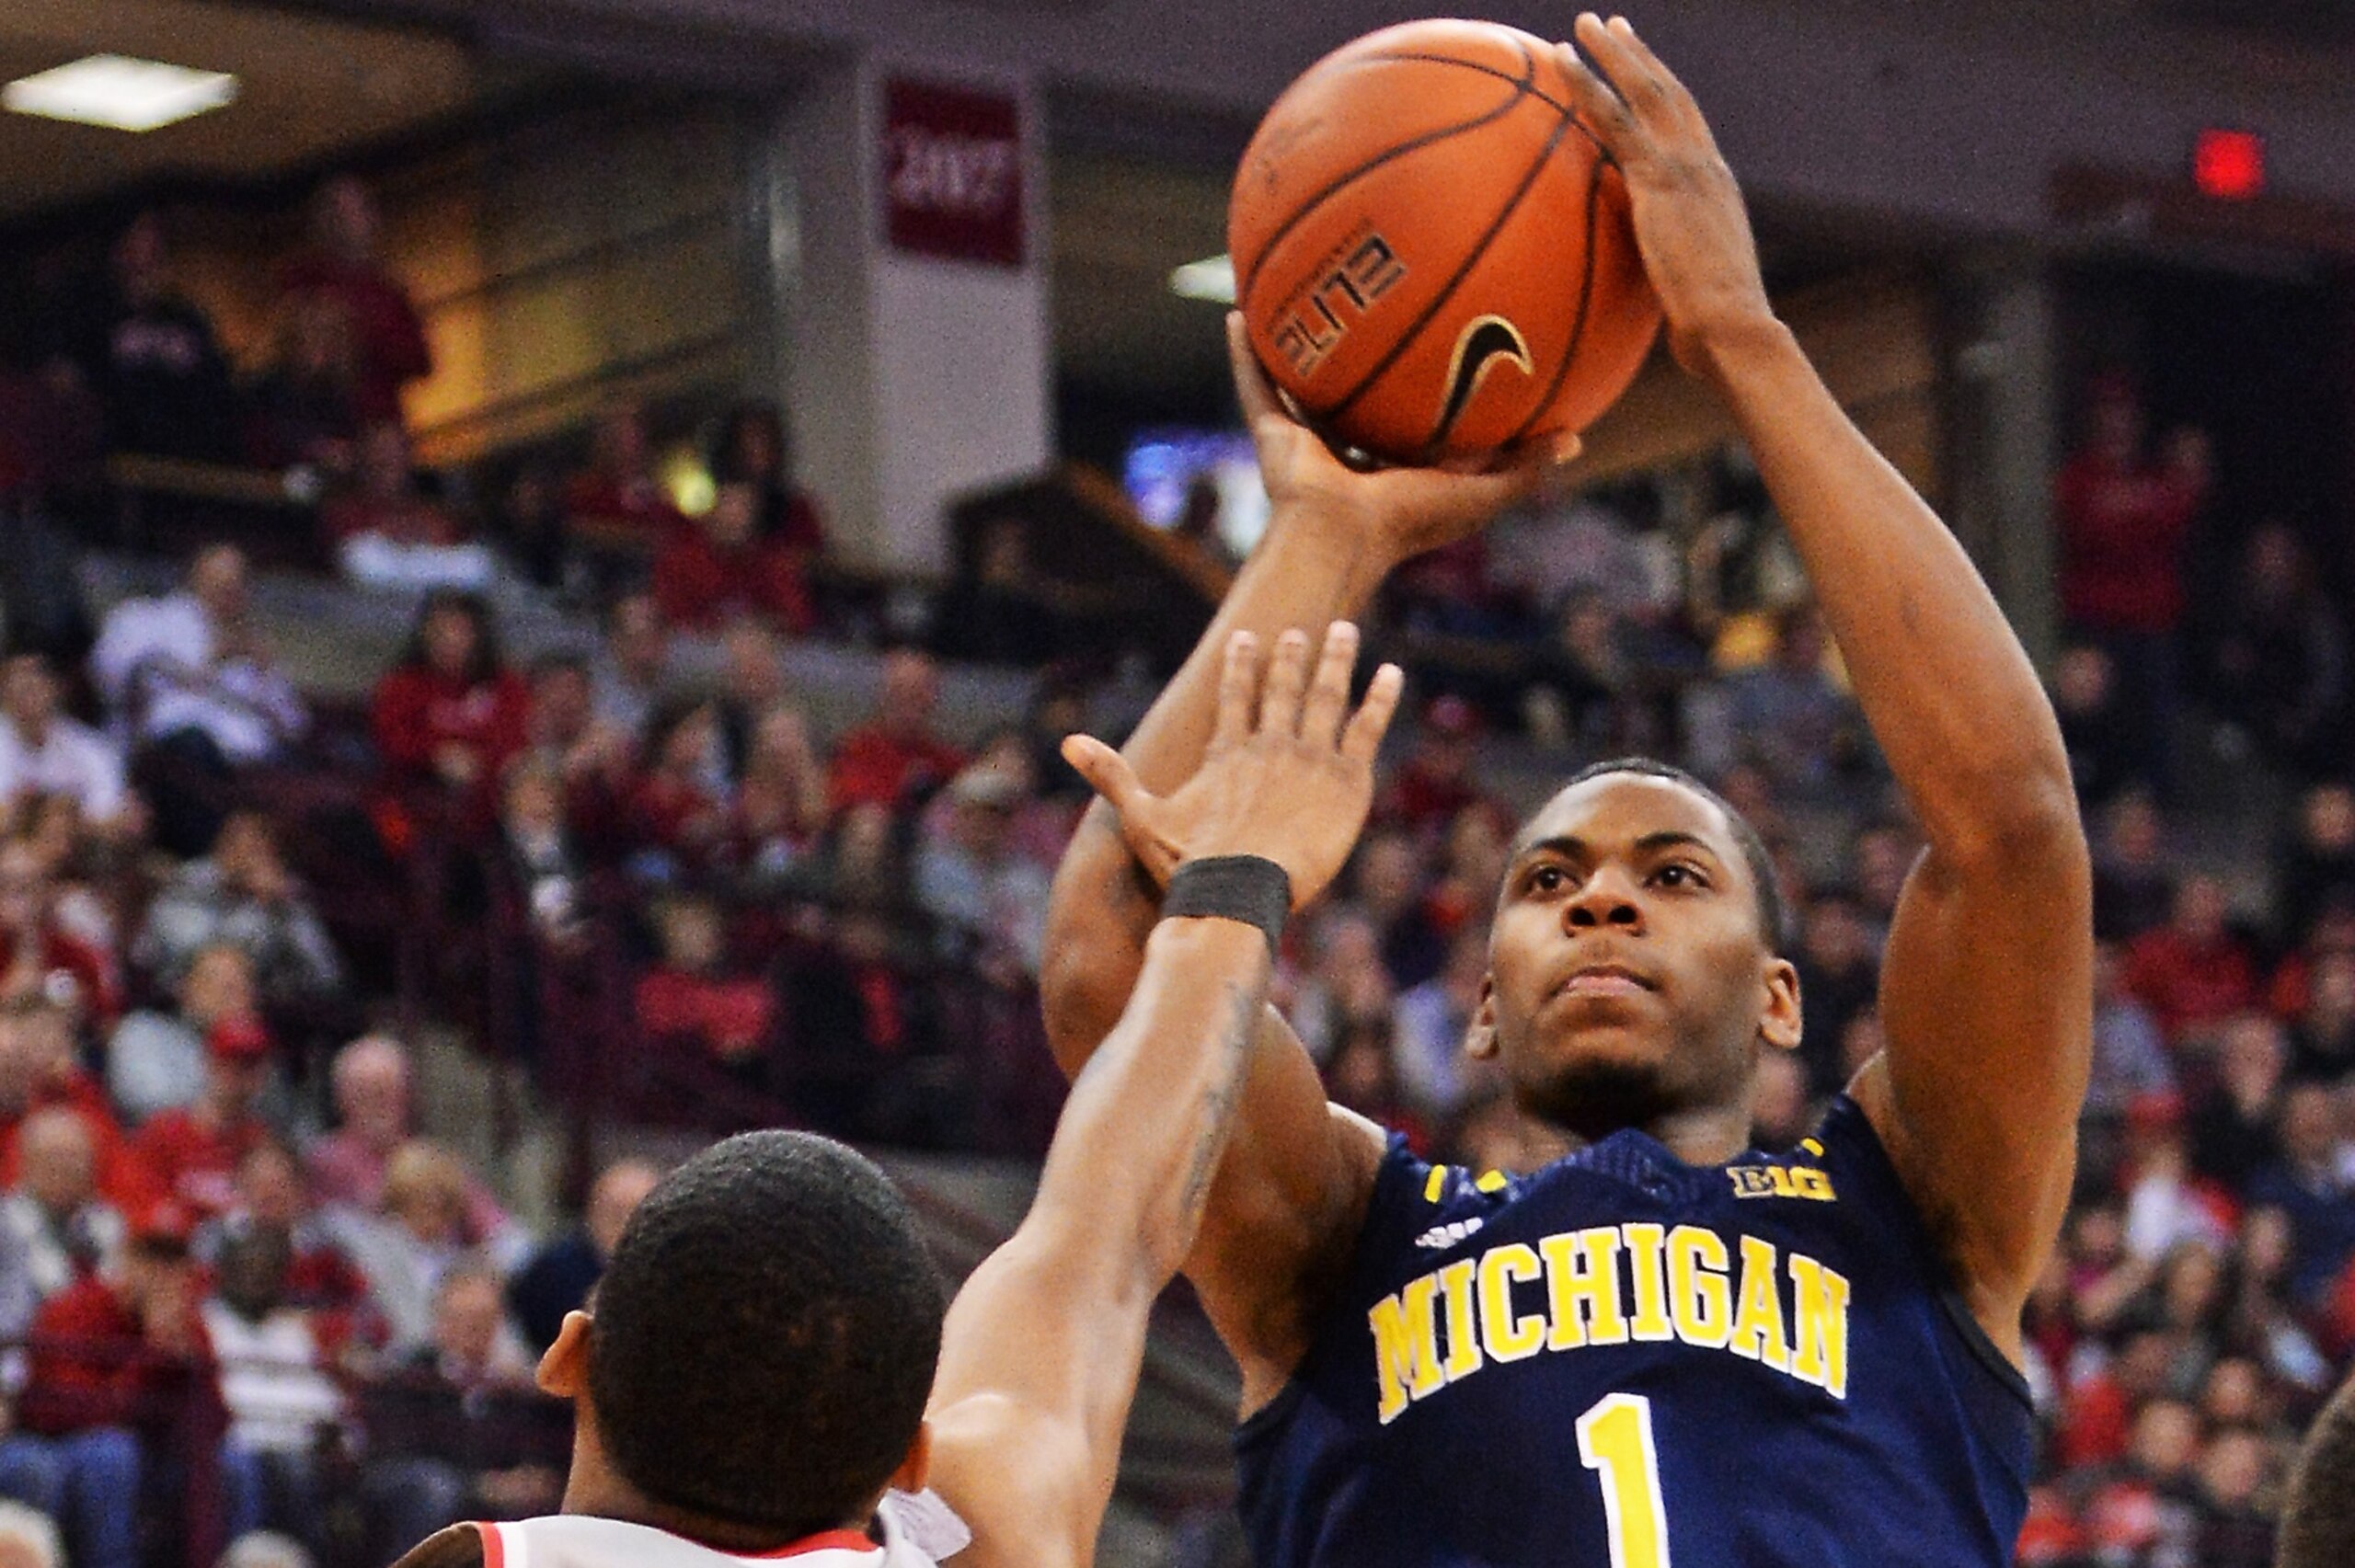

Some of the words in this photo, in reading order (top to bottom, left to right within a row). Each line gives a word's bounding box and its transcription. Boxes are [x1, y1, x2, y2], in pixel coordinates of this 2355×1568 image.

[1273, 234, 1407, 379] ELITE
[1369, 1223, 1849, 1424] MICHIGAN
[1575, 1392, 1671, 1568] 1
